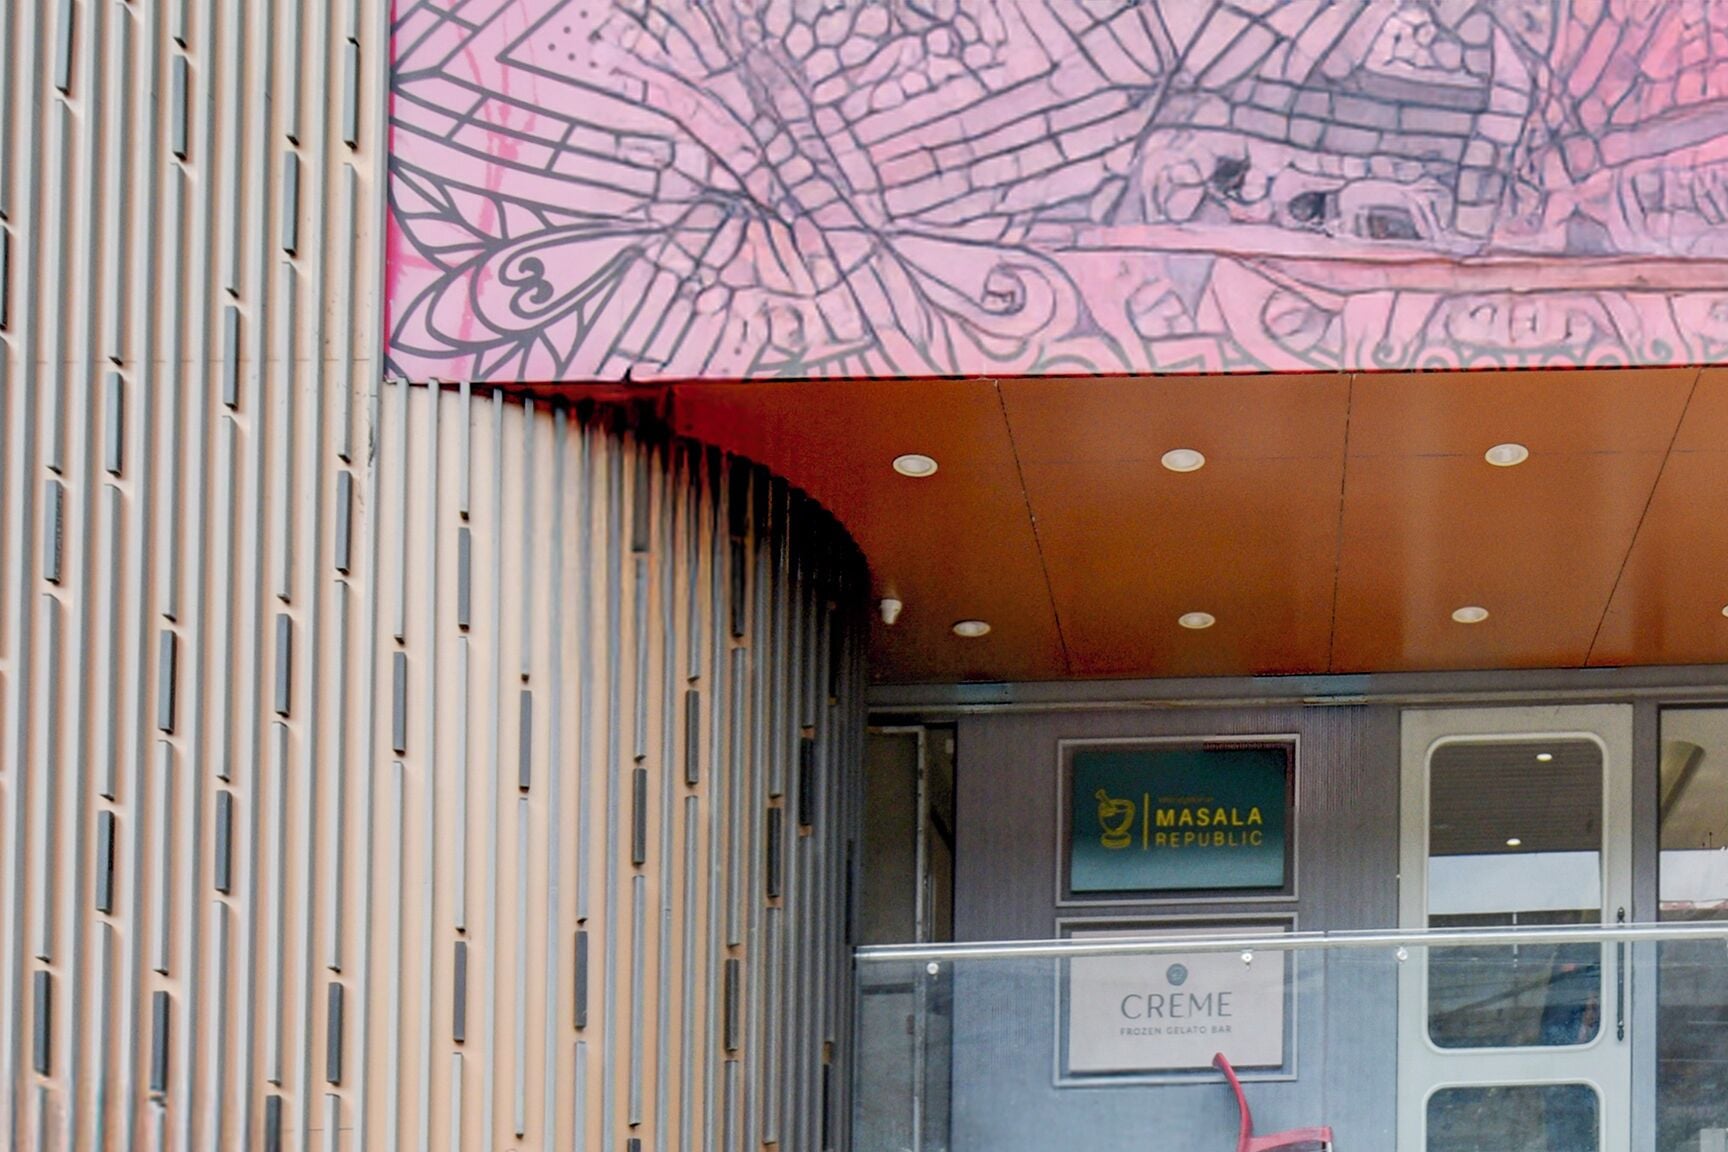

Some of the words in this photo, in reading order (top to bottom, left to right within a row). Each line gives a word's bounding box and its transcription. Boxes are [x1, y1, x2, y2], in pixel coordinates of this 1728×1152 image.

[1155, 806, 1263, 827] MASALA
[1155, 830, 1263, 848] REPUBLIC
[1120, 991, 1233, 1019] CREME
[1120, 1027, 1161, 1036] FROZEN
[1166, 1025, 1207, 1035] GELATO
[1211, 1025, 1232, 1034] BAR
